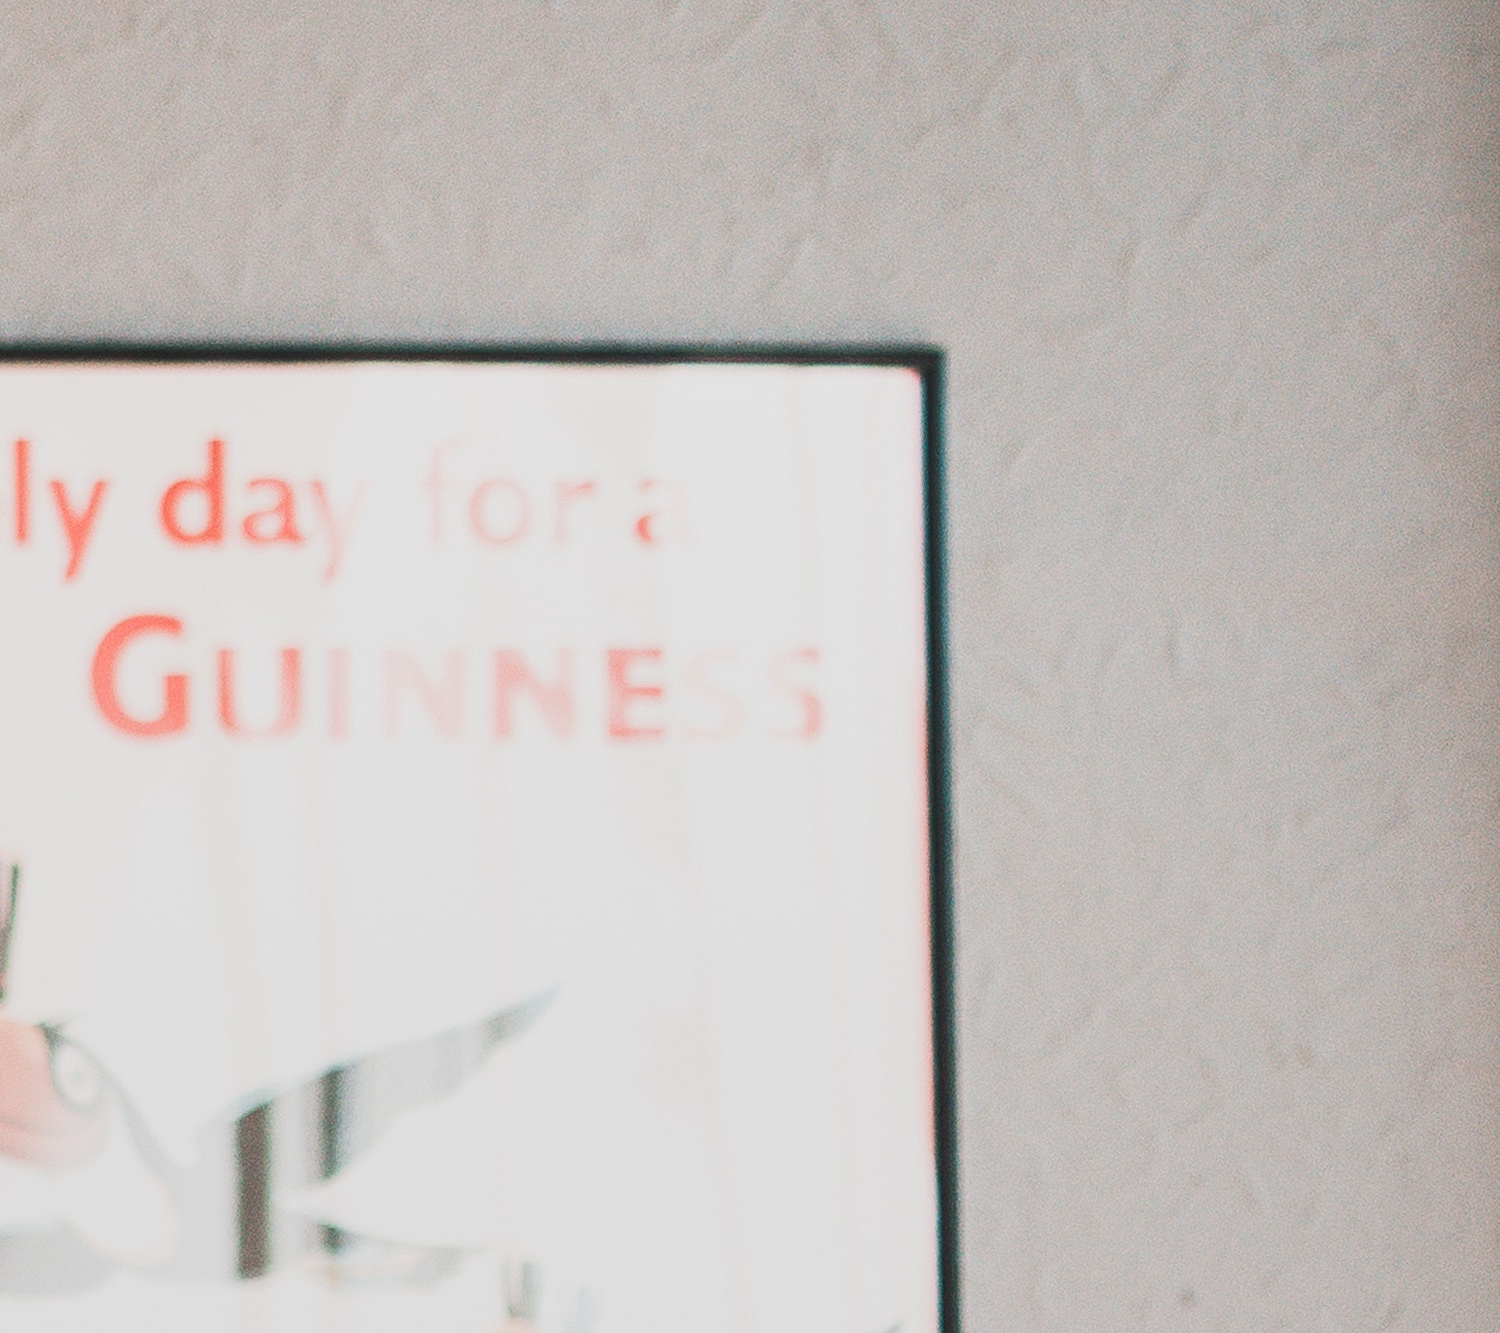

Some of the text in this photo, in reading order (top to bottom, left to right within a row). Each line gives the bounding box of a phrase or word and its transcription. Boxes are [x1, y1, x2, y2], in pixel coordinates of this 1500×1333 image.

[156, 436, 366, 584] day
[422, 438, 598, 550] for
[632, 475, 702, 551] a
[88, 612, 824, 742] GUINNESS
